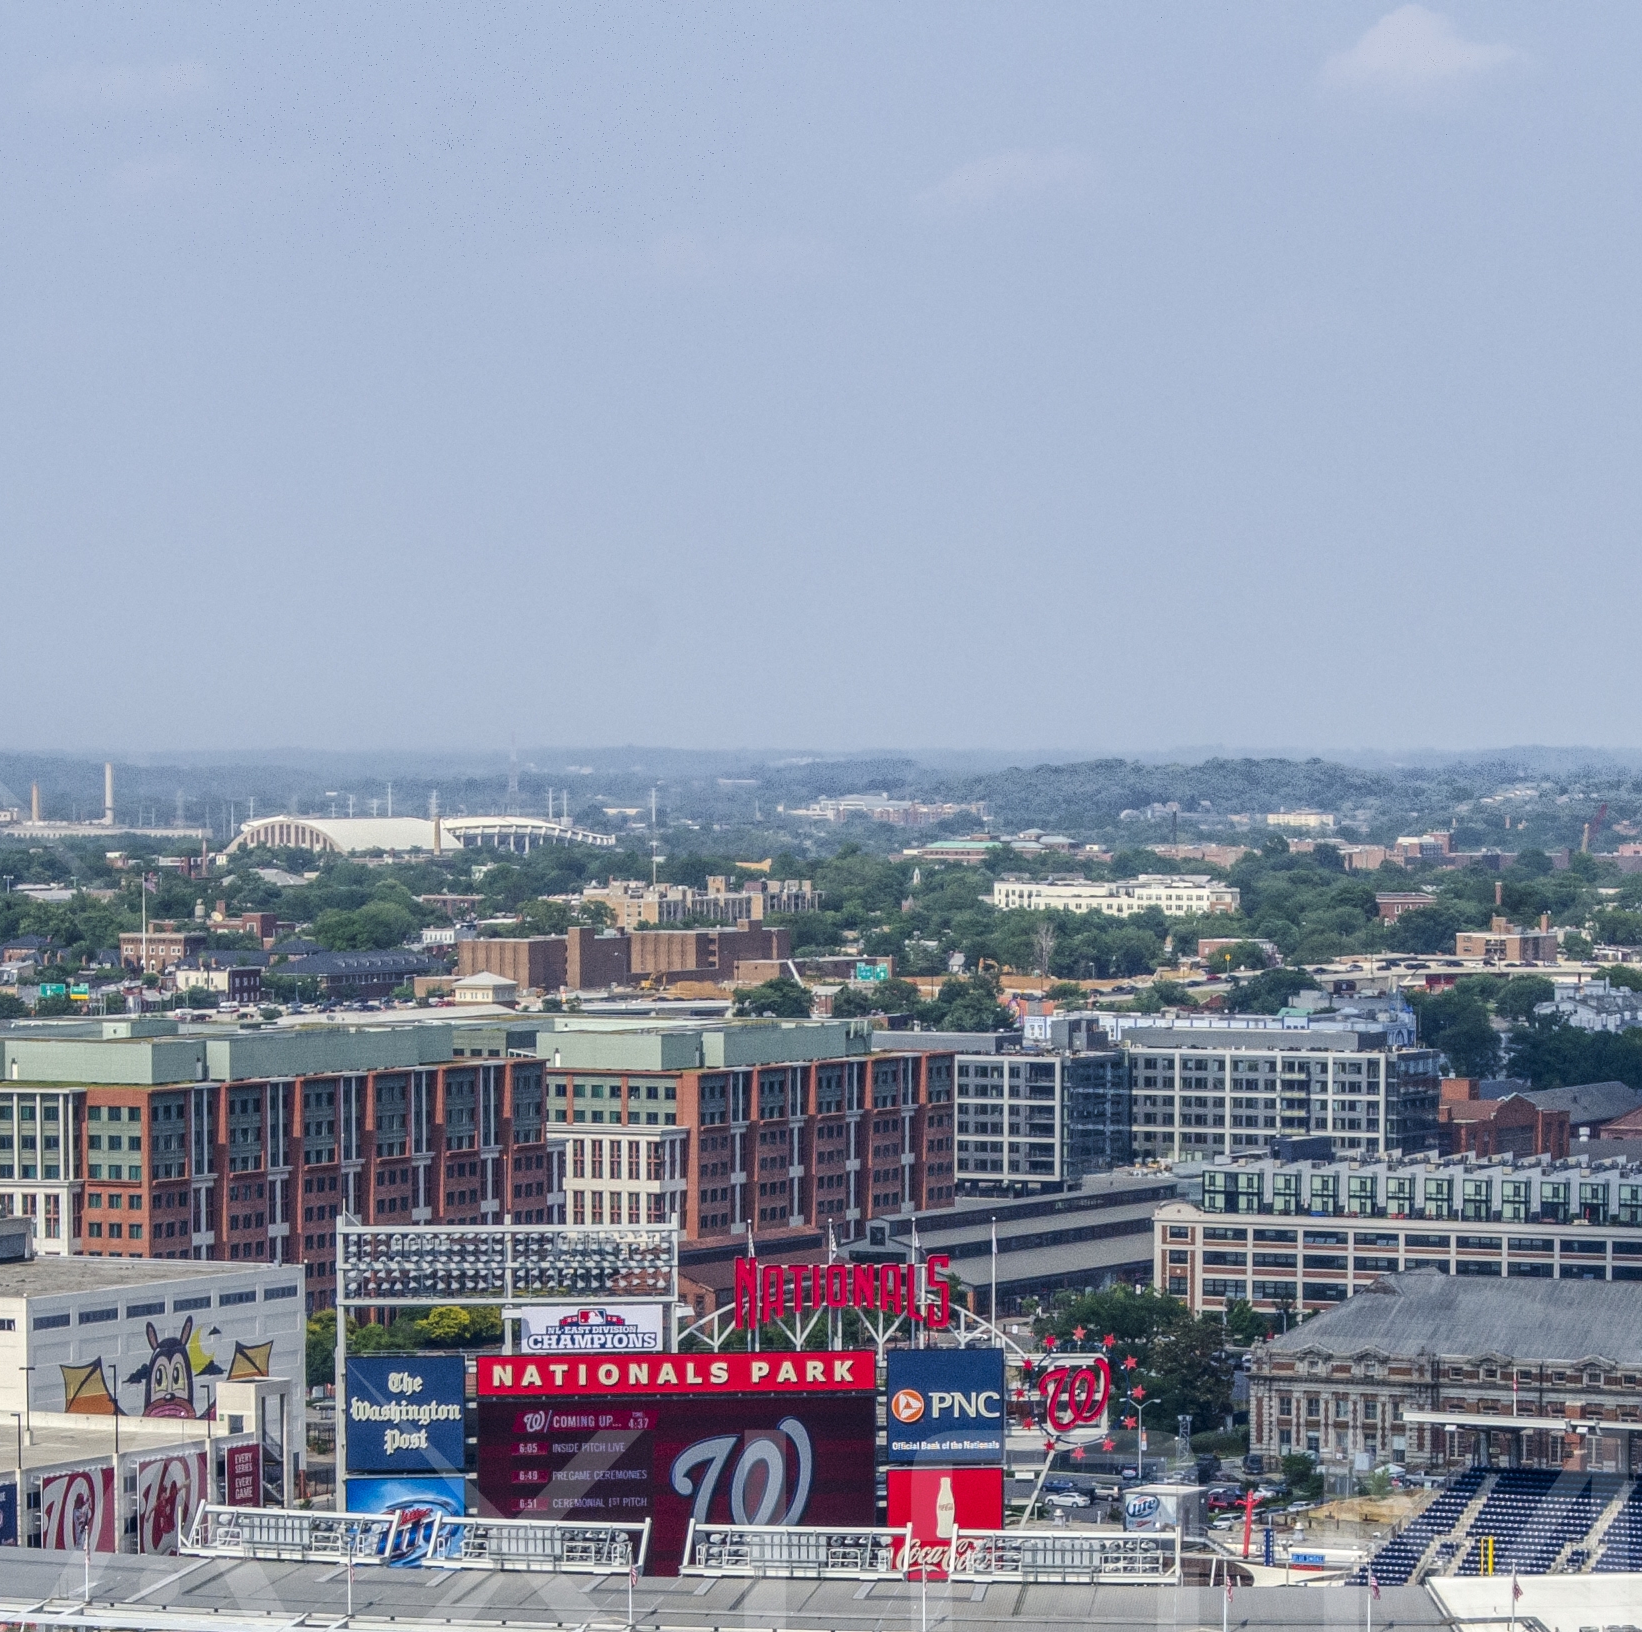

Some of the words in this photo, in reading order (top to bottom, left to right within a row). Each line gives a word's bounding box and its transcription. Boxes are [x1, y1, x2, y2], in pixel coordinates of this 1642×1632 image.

[734, 1254, 950, 1330] NATIONALS
[592, 1326, 637, 1335] DIVISION
[528, 1333, 657, 1349] CHAMPIONS
[492, 1362, 729, 1387] NATIONALS
[752, 1360, 855, 1384] PARK
[388, 1372, 423, 1395] The
[350, 1397, 462, 1425] Washington
[928, 1391, 1000, 1418] PNC
[553, 1415, 595, 1428] COMING
[628, 1418, 649, 1429] 4:37
[384, 1428, 428, 1455] Post
[552, 1443, 579, 1453] INSIDE
[582, 1442, 606, 1453] PITCH
[607, 1442, 626, 1452] LIVE
[892, 1441, 920, 1450] Official
[921, 1441, 940, 1450] Bank
[942, 1441, 950, 1450] of
[952, 1441, 963, 1450] the
[964, 1440, 1000, 1450] Nationals
[234, 1452, 253, 1465] EVERY
[234, 1460, 253, 1473] SERIES
[235, 1475, 253, 1488] EVERY
[552, 1470, 591, 1481] PREGAME
[593, 1469, 648, 1480] CEREMONIES
[235, 1485, 253, 1499] GAME
[552, 1497, 606, 1509] CEREMONIAL
[607, 1497, 620, 1508] 1ST
[622, 1497, 648, 1508] PITCH
